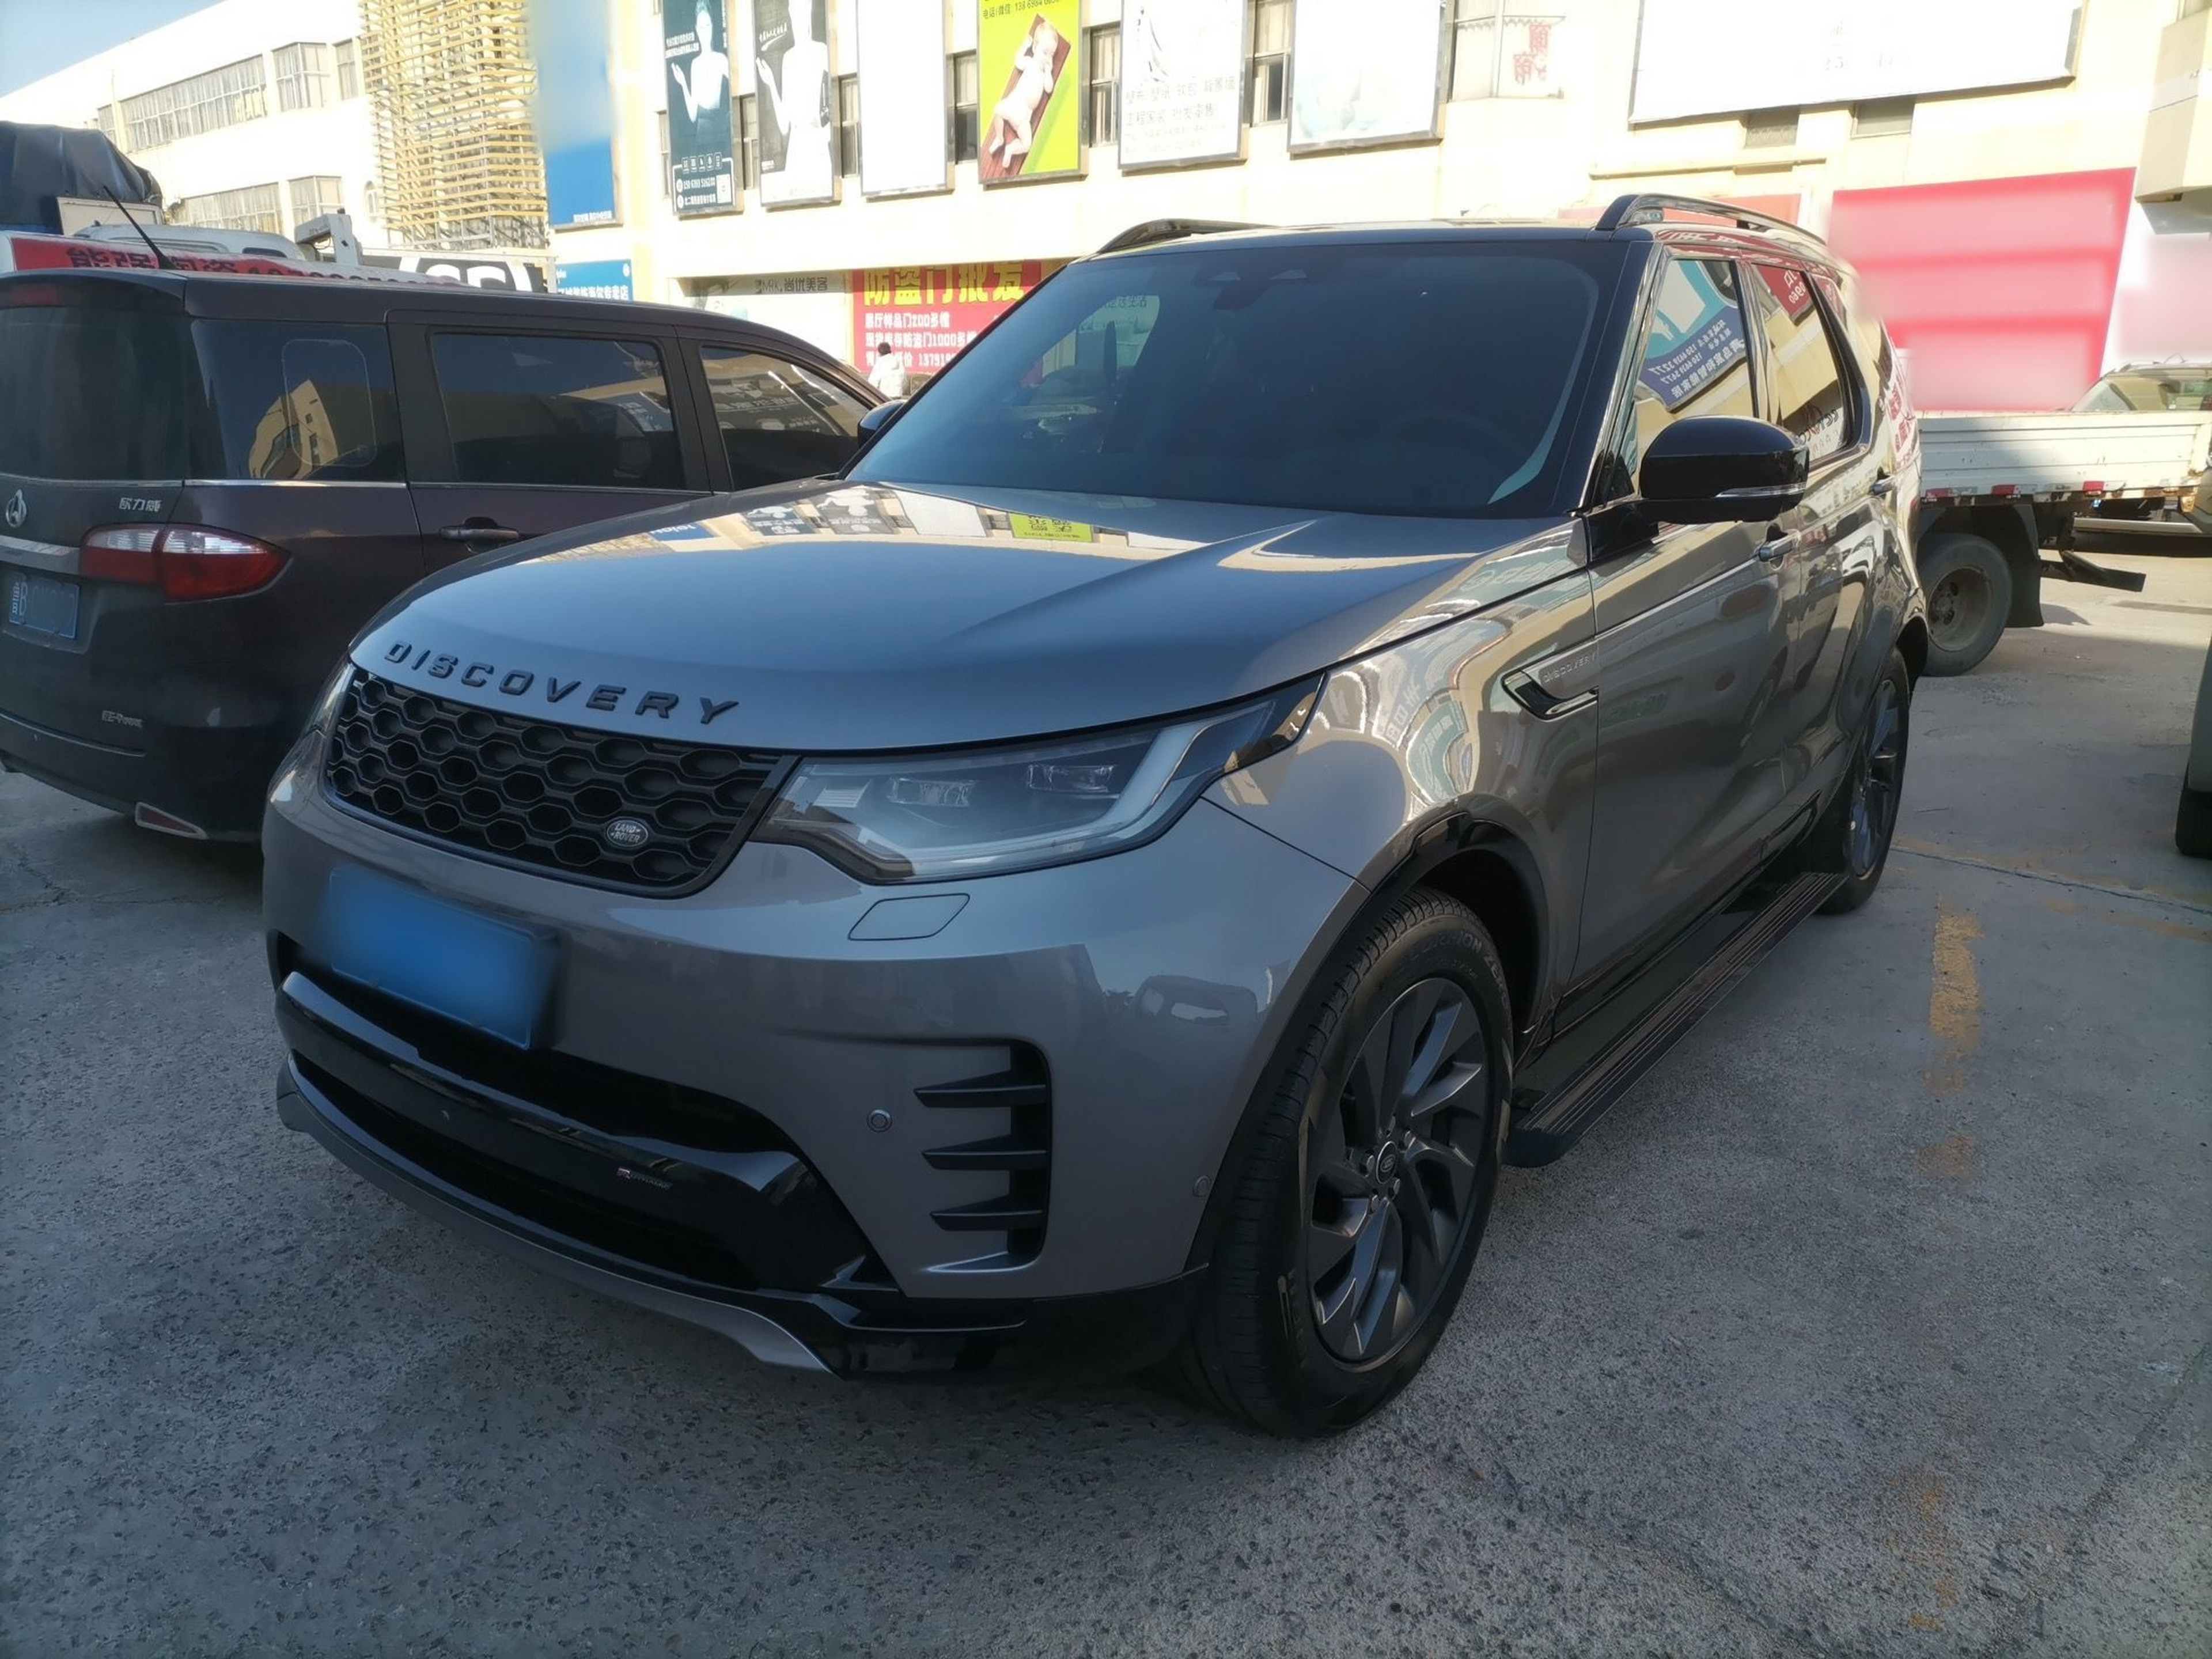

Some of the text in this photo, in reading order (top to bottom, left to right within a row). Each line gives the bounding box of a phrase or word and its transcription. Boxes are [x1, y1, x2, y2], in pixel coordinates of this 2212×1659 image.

[864, 262, 1024, 306] 防盗门批发
[119, 497, 162, 512] 欧力威
[384, 641, 740, 725] DISCOVERY
[615, 823, 637, 833] LAND
[613, 831, 641, 843] ROVER
